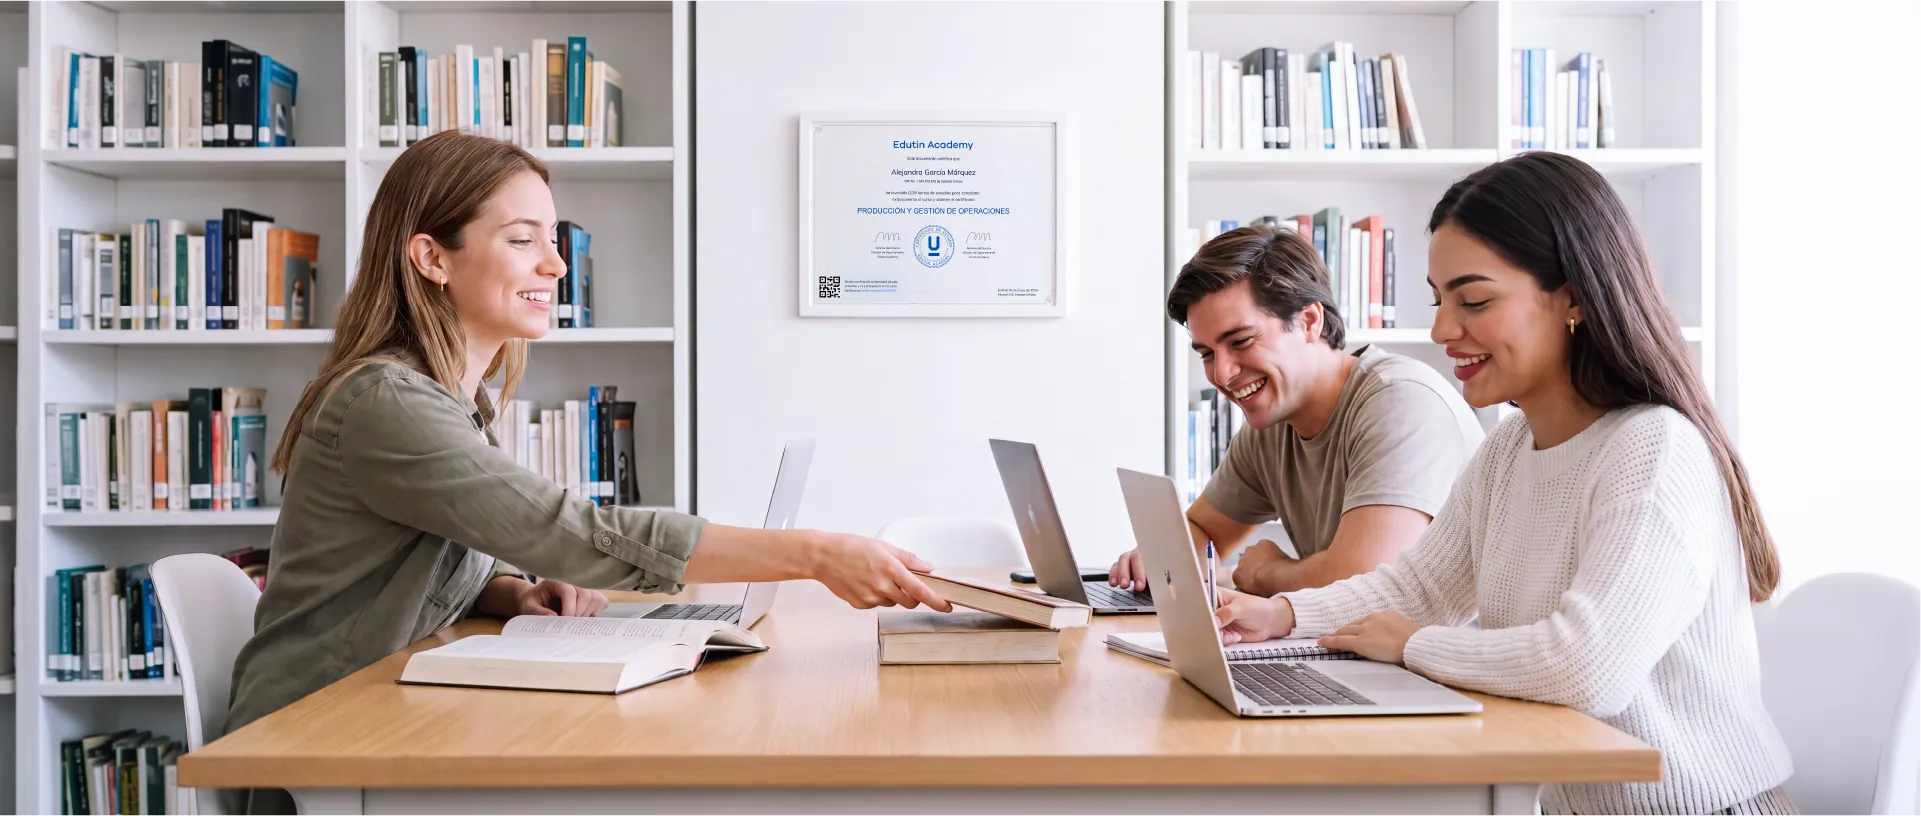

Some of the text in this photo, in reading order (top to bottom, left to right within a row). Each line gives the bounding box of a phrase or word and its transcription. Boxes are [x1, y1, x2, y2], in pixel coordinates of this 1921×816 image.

[893, 140, 974, 150] Edutin Academy
[891, 168, 976, 177] Alejandra García Márquez
[857, 206, 1010, 215] PRODUCCIÓN Y GESTIÓN DE OPERACIONES
